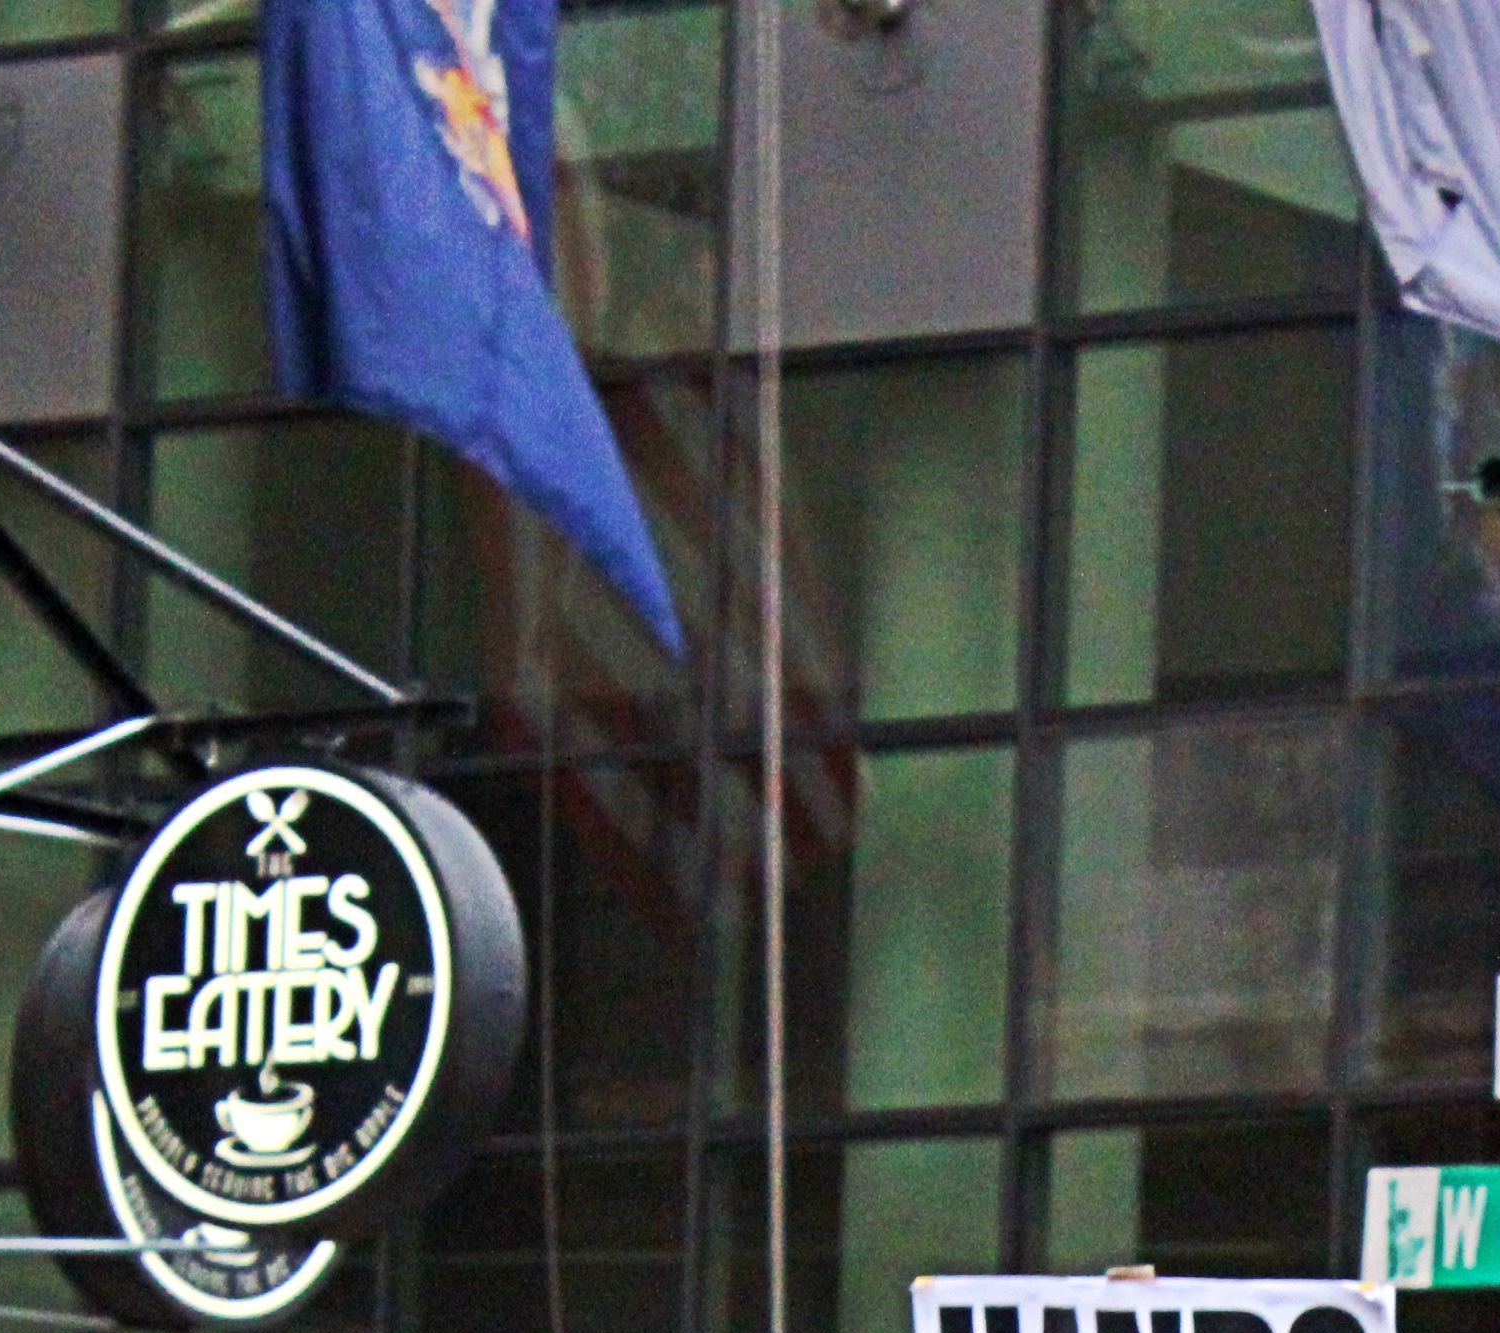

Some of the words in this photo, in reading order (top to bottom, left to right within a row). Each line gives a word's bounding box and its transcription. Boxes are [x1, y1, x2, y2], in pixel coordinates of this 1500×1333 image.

[171, 873, 378, 976] TIMES
[142, 962, 399, 1071] EATERY
[1442, 1185, 1488, 1269] W
